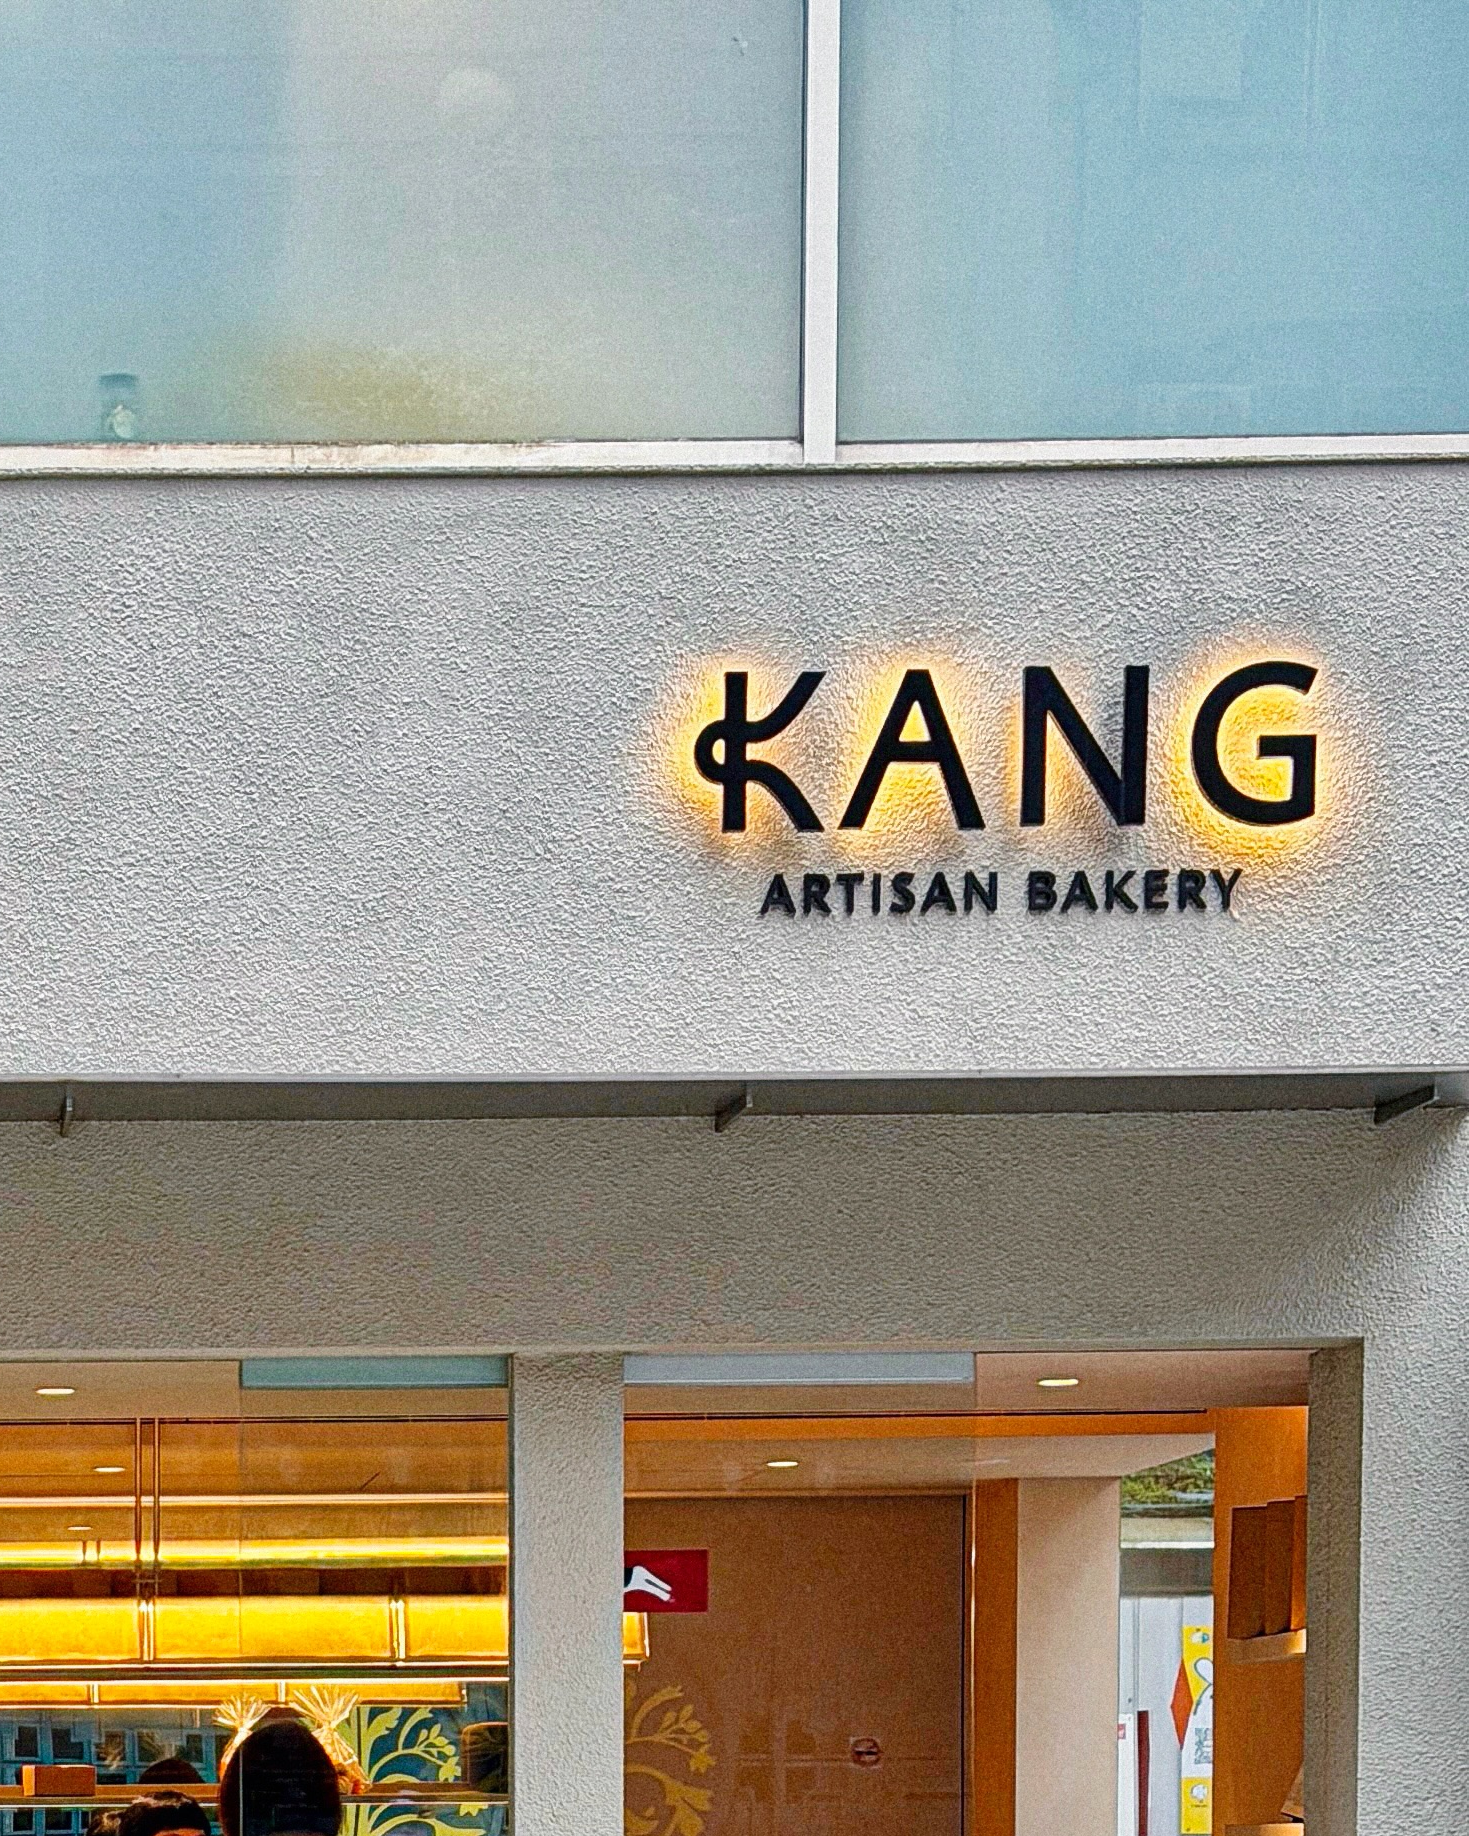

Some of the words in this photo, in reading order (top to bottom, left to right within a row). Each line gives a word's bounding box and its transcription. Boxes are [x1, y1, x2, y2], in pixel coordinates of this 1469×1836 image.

[694, 660, 1318, 833] KANG
[759, 870, 999, 918] ARTISAN
[1026, 868, 1244, 917] BAKERY
